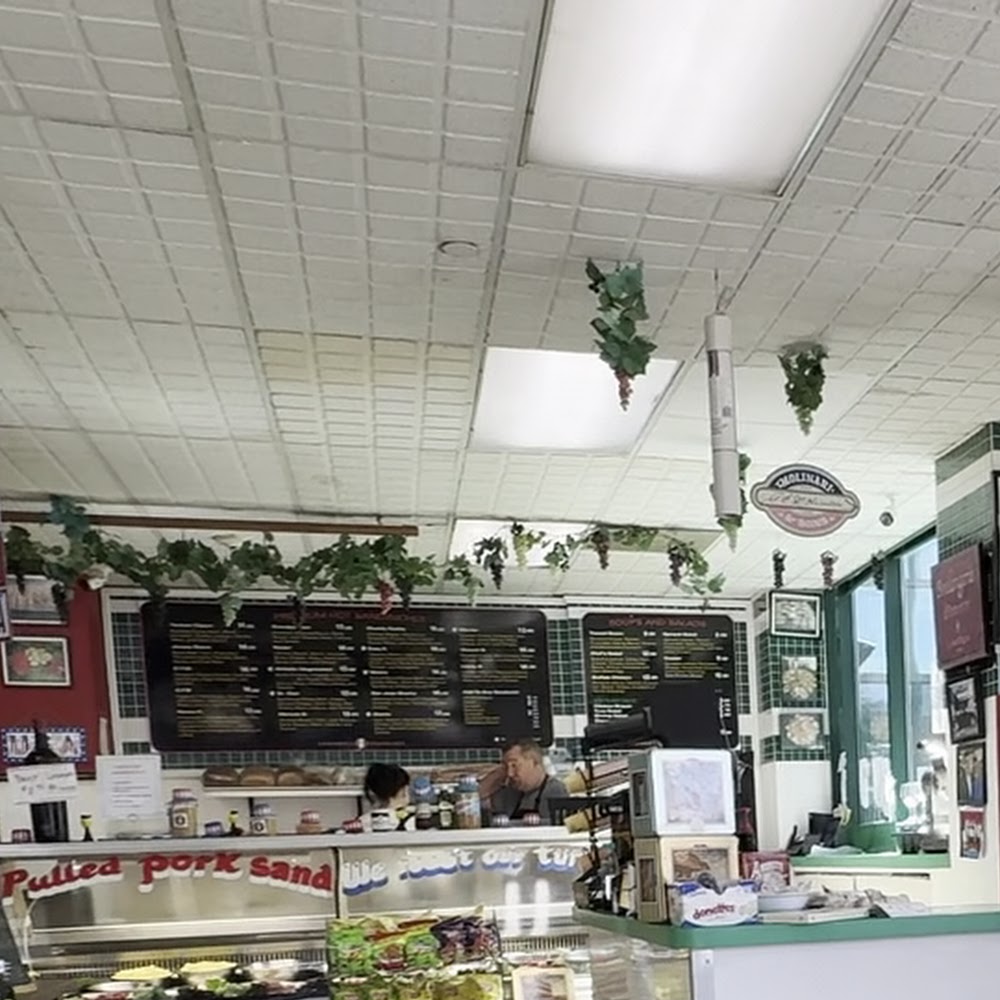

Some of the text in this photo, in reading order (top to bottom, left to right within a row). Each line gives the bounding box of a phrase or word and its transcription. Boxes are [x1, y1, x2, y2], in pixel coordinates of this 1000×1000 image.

[2, 852, 332, 898] Pulled pork sand
